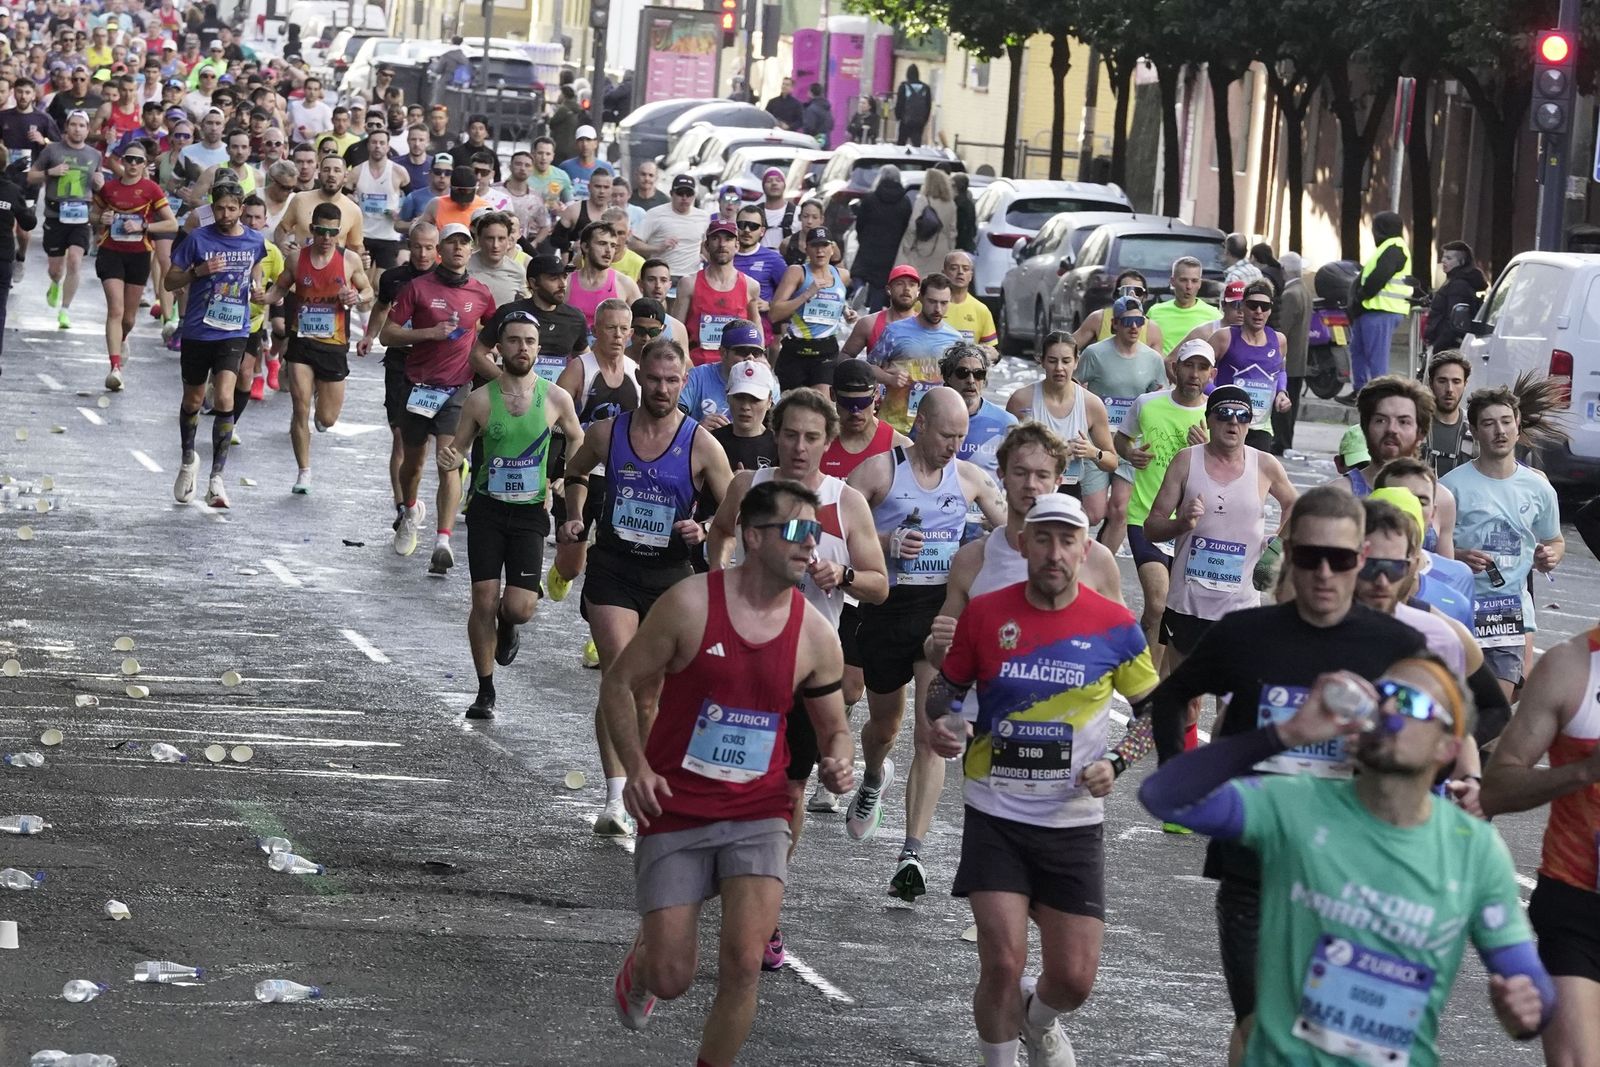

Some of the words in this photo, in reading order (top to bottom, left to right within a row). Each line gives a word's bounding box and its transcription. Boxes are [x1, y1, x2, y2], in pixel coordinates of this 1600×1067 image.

[208, 310, 216, 318] EL
[218, 313, 243, 323] GUAPO
[304, 323, 330, 331] TULKAS
[959, 443, 998, 453] URICH
[506, 459, 534, 467] ZURICH
[505, 482, 524, 491] BEN
[637, 491, 670, 504] ZURICH
[634, 506, 654, 518] 6729
[618, 515, 665, 533] ARNAUD
[1209, 542, 1241, 553] ZURICH
[1186, 567, 1206, 577] WILLY
[1207, 571, 1242, 583] BOLSSENS
[1482, 598, 1515, 609] ZURICH
[1475, 623, 1520, 638] MANUEL
[1052, 660, 1086, 671] ATLETISMO
[1000, 661, 1085, 687] PALACIEGO
[727, 712, 769, 727] ZURICH
[1017, 725, 1064, 737] ZURICH
[722, 734, 746, 746] 6303
[712, 747, 746, 765] LUIS
[1018, 747, 1044, 759] 5160
[1031, 769, 1070, 780] BEGINES
[1356, 952, 1420, 983] ZURICH
